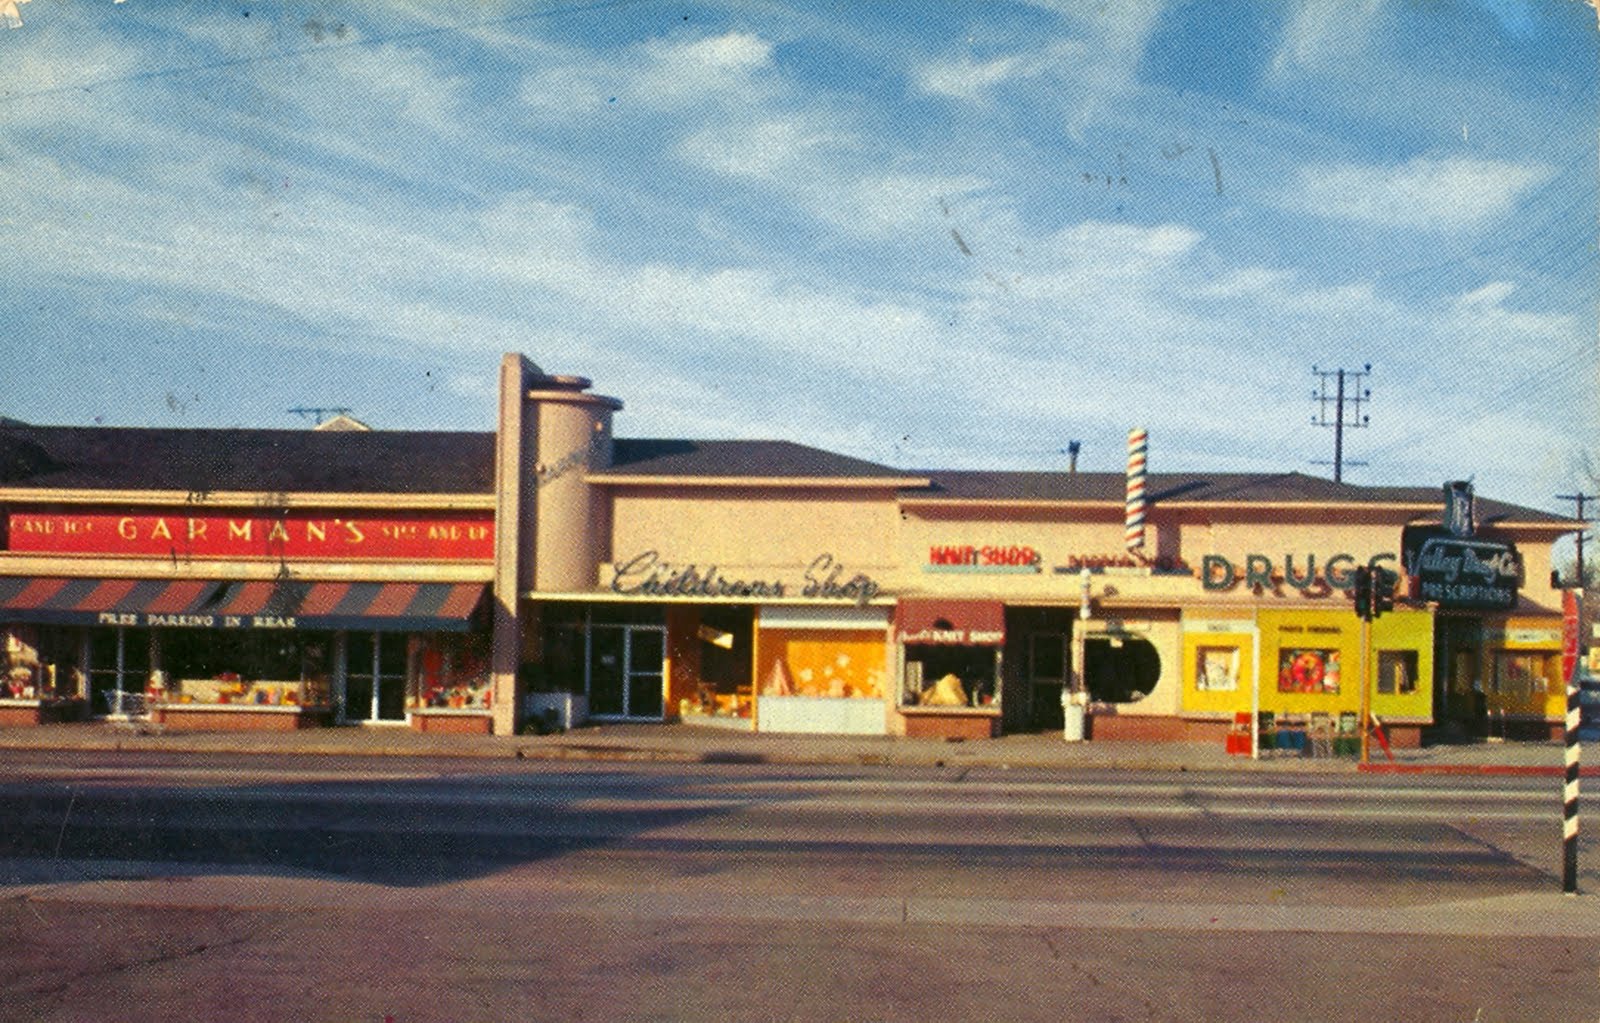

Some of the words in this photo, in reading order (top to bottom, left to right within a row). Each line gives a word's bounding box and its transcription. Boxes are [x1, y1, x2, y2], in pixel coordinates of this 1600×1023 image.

[118, 517, 365, 543] GARMAN'S
[427, 524, 461, 541] AND
[980, 545, 1036, 566] SHOP
[802, 552, 879, 607] Shop
[99, 612, 138, 626] FREE
[148, 614, 214, 628] PARKING
[225, 616, 242, 628] IN
[253, 616, 297, 628] REAR
